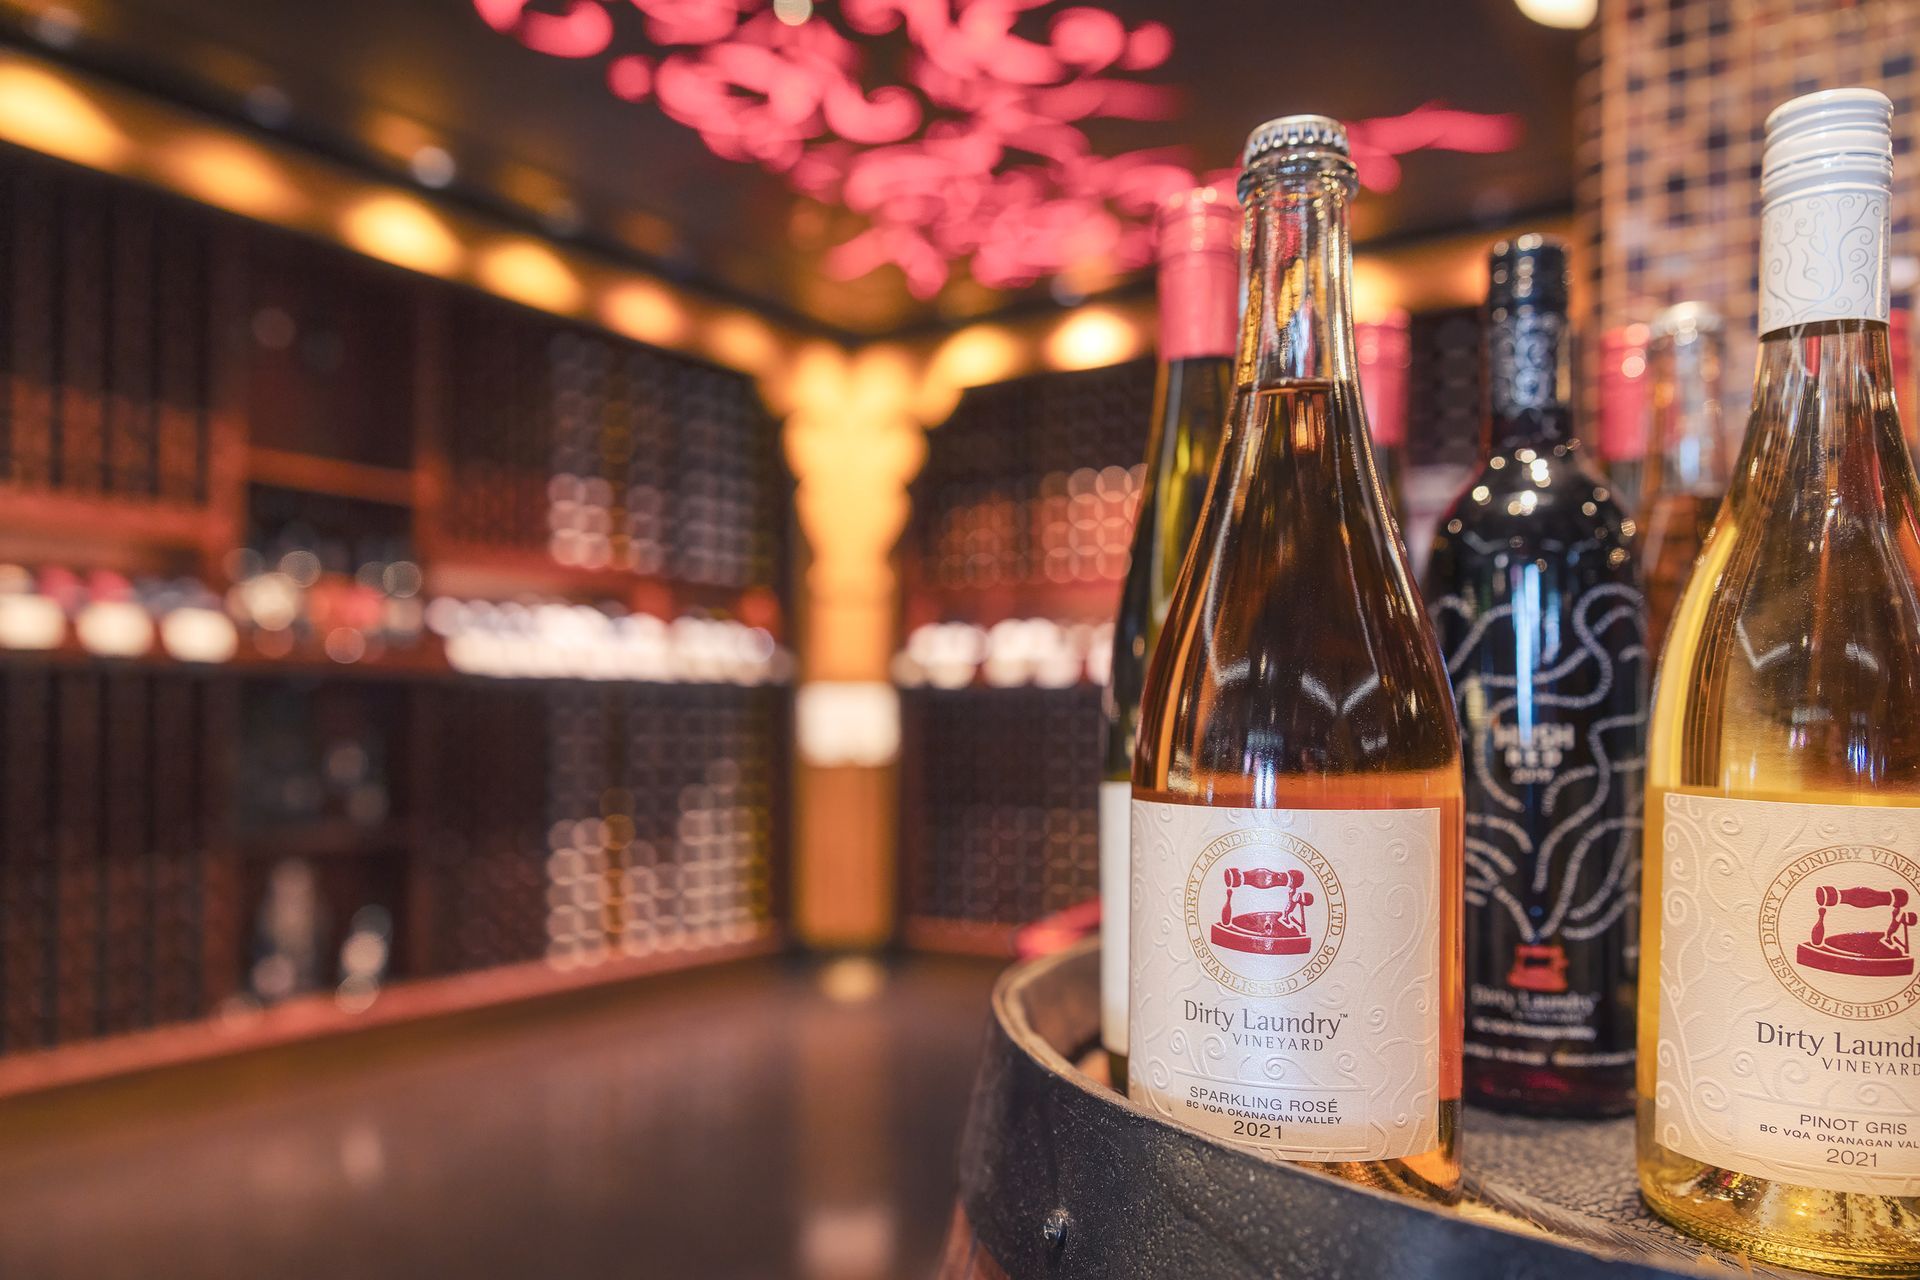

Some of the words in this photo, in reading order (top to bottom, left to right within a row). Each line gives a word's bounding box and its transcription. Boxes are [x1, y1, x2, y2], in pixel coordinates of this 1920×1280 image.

[1186, 875, 1200, 926] DIRTY
[1196, 830, 1264, 873] LAUNDRY
[1268, 830, 1340, 897] VINEYARD
[1328, 902, 1344, 938] LTD.
[1762, 891, 1782, 946] DIRTY
[1776, 847, 1862, 891] LAUNDRY
[1871, 849, 1920, 888] VINEY
[1193, 936, 1298, 995] ESTABLISHED
[1303, 944, 1335, 982] 2006
[1769, 954, 1899, 1018] ESTABLISHED
[1184, 1000, 1235, 1033] Dirty
[1232, 1032, 1324, 1051] VINEYARD
[1755, 1021, 1825, 1057] Dirty
[1821, 1057, 1920, 1076] VINEYARD
[1186, 1100, 1199, 1109] BC
[1202, 1103, 1224, 1114] VQA
[1227, 1108, 1293, 1123] OKANAGAN
[1298, 1115, 1342, 1125] VALLEY
[1190, 1086, 1282, 1111] SPARKLING
[1289, 1098, 1338, 1113] ROSÉ
[1233, 1120, 1283, 1140] 2021
[1759, 1124, 1778, 1134] BC
[1783, 1128, 1811, 1140] VQA
[1816, 1133, 1893, 1148] OKANAGAN
[1897, 1140, 1920, 1149] VAL
[1800, 1114, 1859, 1132] PINOT
[1865, 1121, 1908, 1136] GRIS
[1826, 1148, 1878, 1168] 2021
